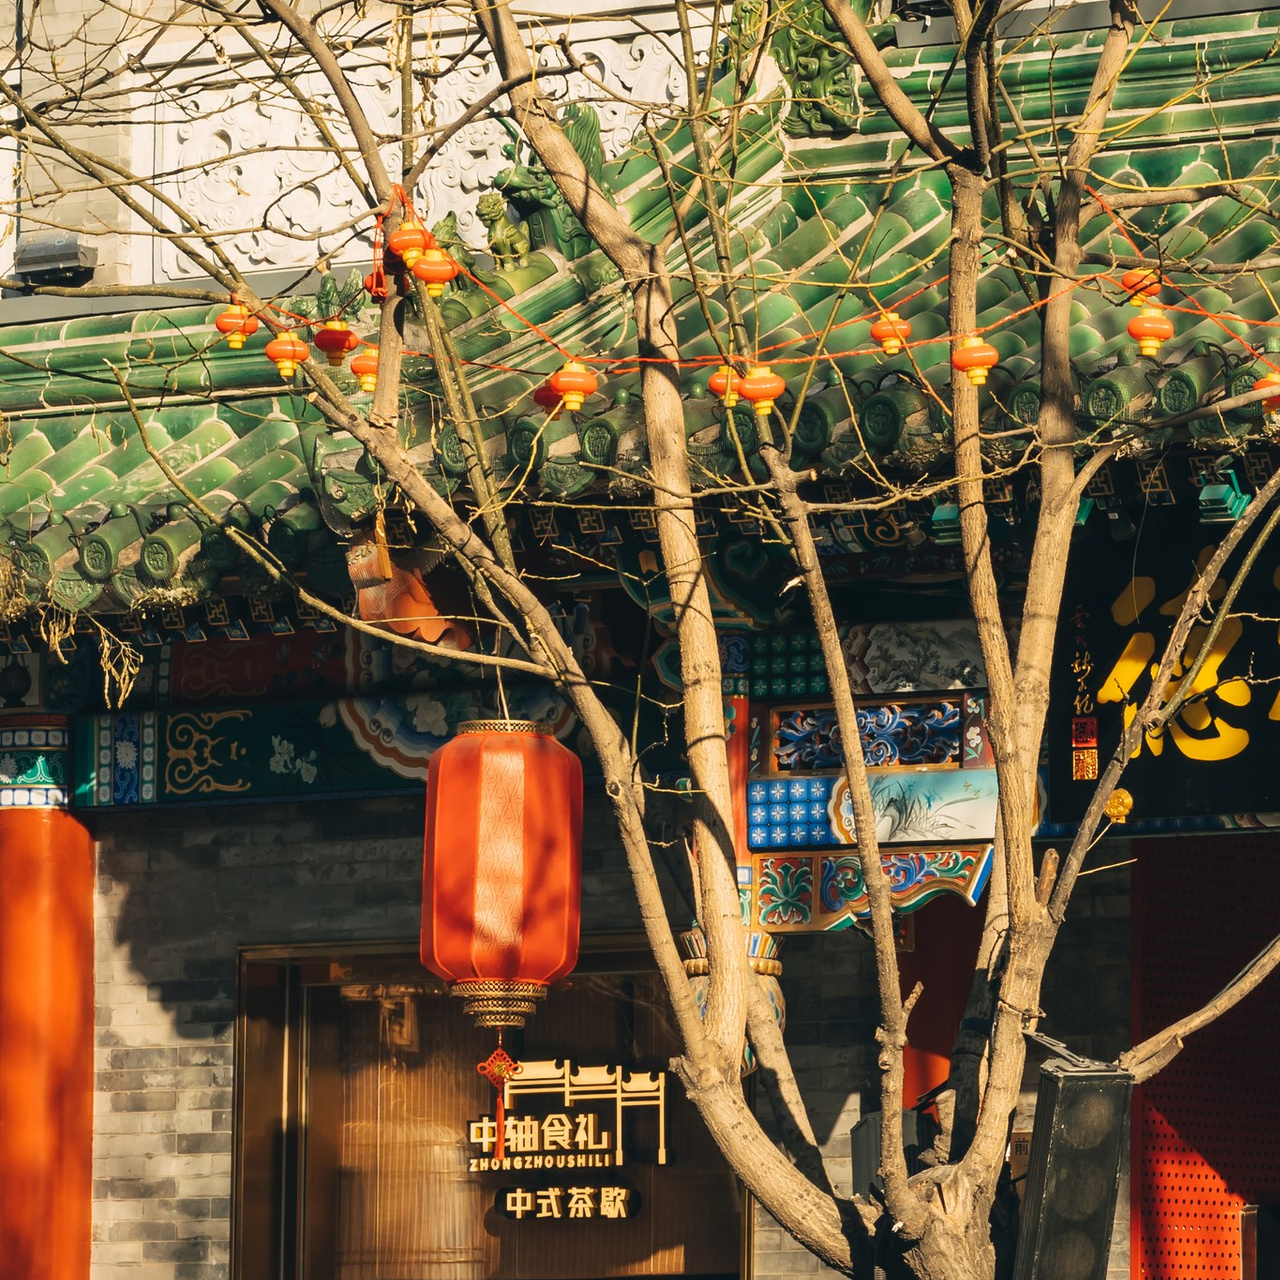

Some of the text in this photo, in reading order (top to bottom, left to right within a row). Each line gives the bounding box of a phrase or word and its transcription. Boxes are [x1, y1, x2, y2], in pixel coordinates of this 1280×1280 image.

[469, 1113, 611, 1153] 中轴食礼
[469, 1154, 611, 1172] ZHONGZHOUSHILI
[506, 1186, 630, 1220] 中式茶歇
